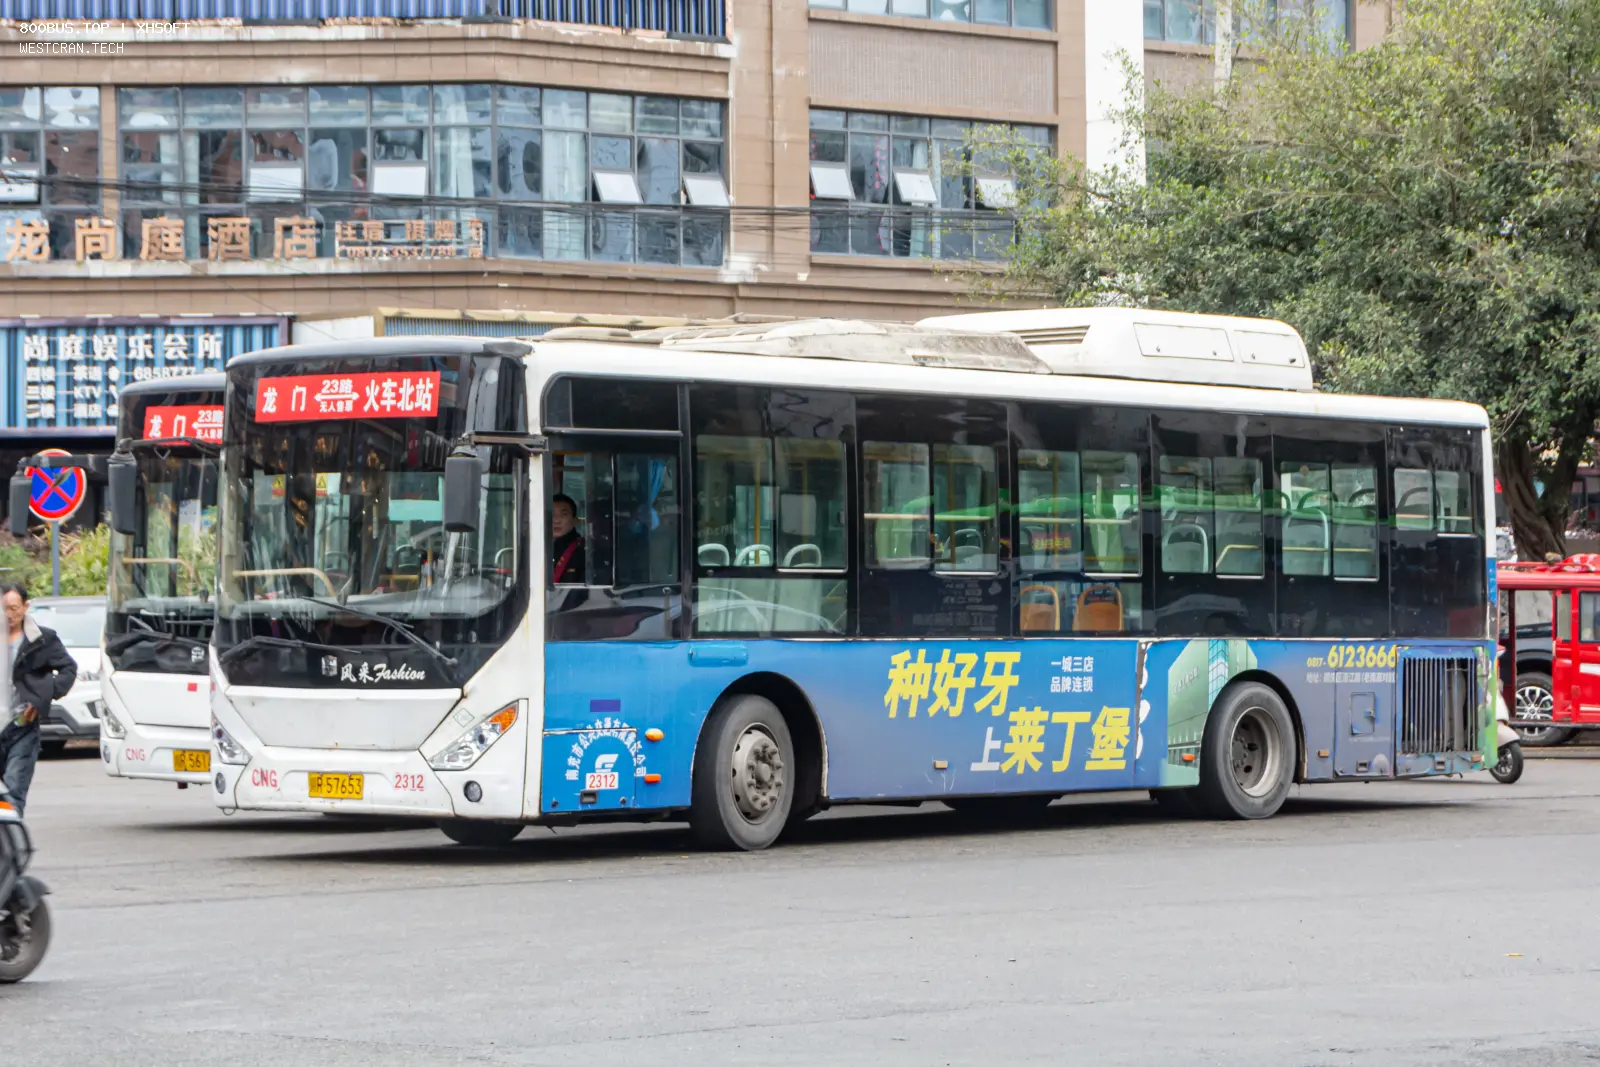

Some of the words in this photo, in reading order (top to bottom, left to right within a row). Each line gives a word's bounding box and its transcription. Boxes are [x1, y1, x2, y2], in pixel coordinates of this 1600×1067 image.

[5, 216, 317, 261] 龙尚庭酒店
[24, 333, 223, 361] 尚庭娱乐会所
[73, 385, 102, 399] KTV
[321, 379, 353, 393] 23路
[363, 377, 434, 412] 火车北站
[257, 386, 307, 414] 龙门
[341, 661, 374, 684] 风采
[373, 662, 426, 683] Fashion
[1051, 655, 1094, 673] 一城三店
[884, 648, 1021, 718] 种好牙
[1050, 676, 1093, 693] 品牌连锁
[970, 706, 1131, 774] 上莱丁堡
[125, 748, 146, 761] CNG
[252, 768, 278, 788] CNG
[394, 773, 424, 789] 2312
[589, 773, 616, 789] 2312
